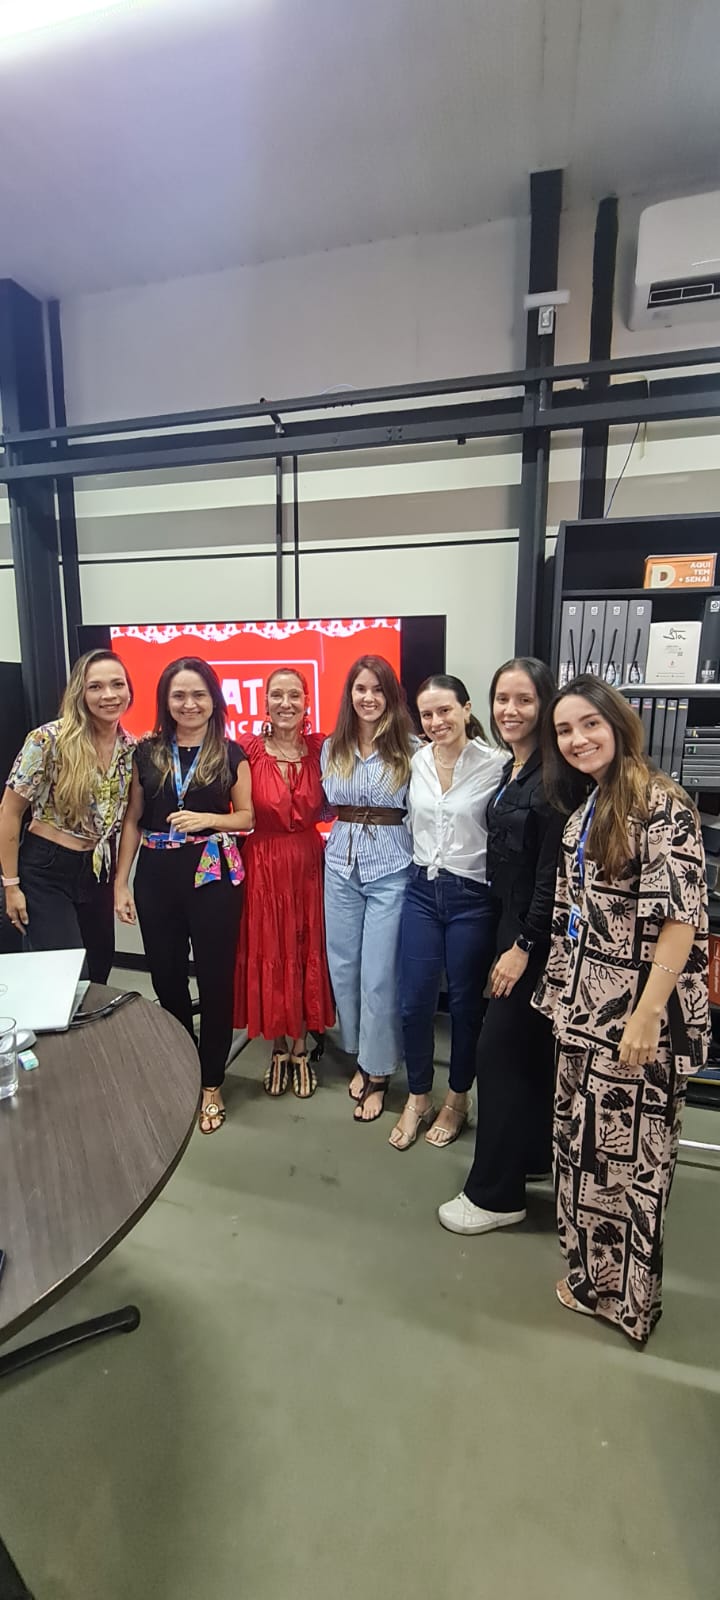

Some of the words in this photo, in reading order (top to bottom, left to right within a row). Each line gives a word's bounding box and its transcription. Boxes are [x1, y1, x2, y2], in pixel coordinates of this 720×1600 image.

[690, 561, 711, 569] AQUI
[685, 576, 710, 584] SENAI
[220, 678, 264, 716] AT
